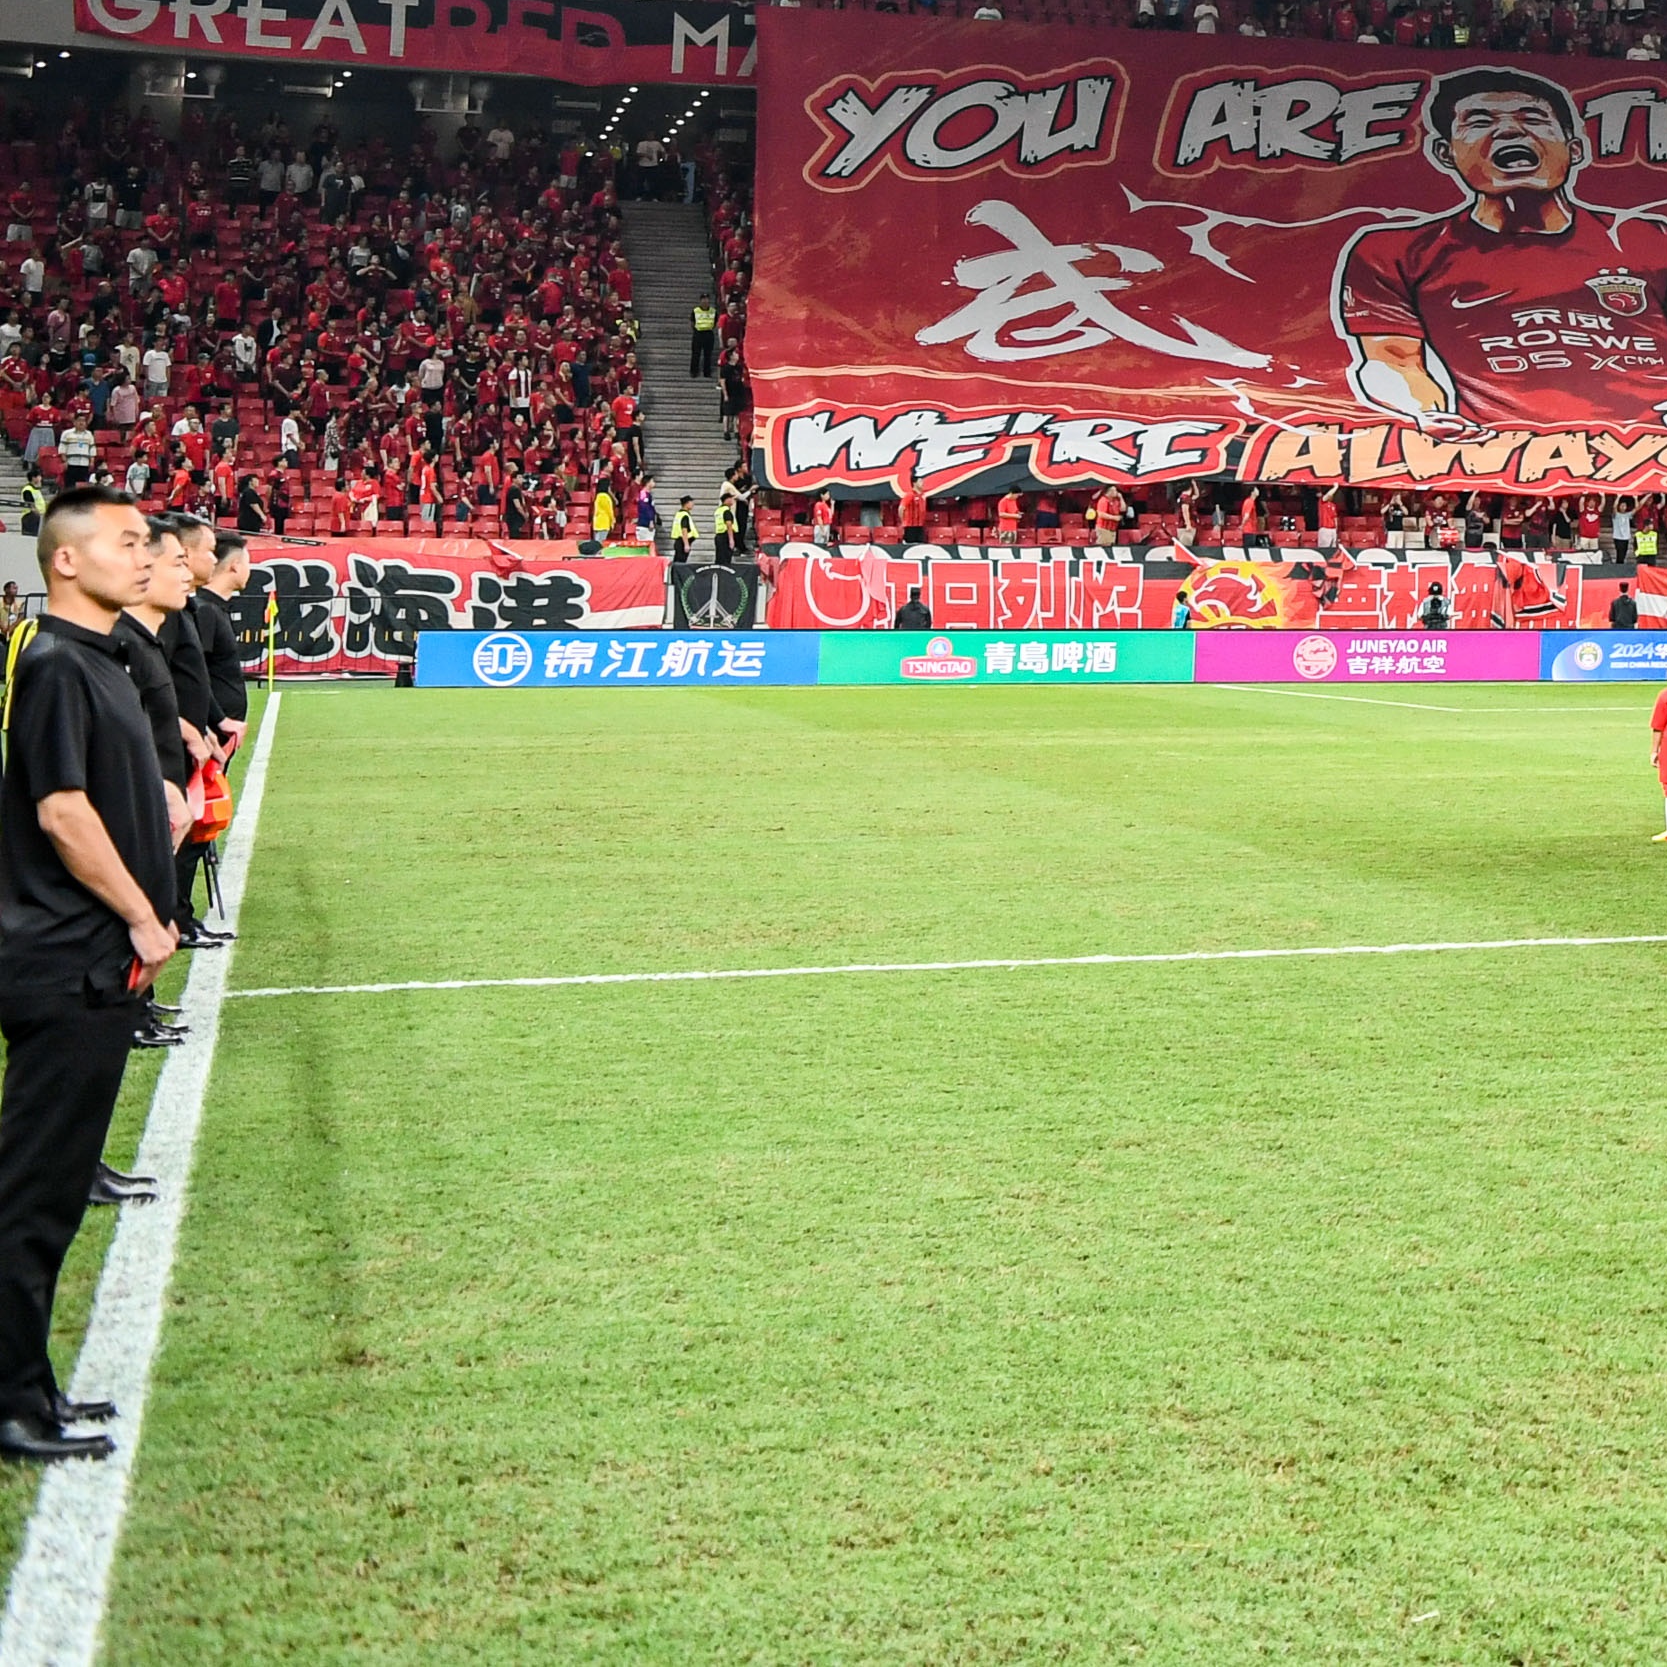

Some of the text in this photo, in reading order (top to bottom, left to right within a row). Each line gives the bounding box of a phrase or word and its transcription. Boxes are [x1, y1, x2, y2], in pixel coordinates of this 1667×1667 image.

[824, 74, 1116, 178] YOU
[1176, 78, 1423, 167] ARE
[1479, 328, 1658, 353] ROEWE
[782, 412, 1227, 479] WE'RE
[543, 640, 766, 679] 锦江航运
[984, 641, 1117, 674] 青岛啤酒
[1347, 639, 1447, 654] JUNEYAO AIR
[907, 661, 971, 674] TSINGTAO
[1346, 656, 1447, 675] 吉祥航空
